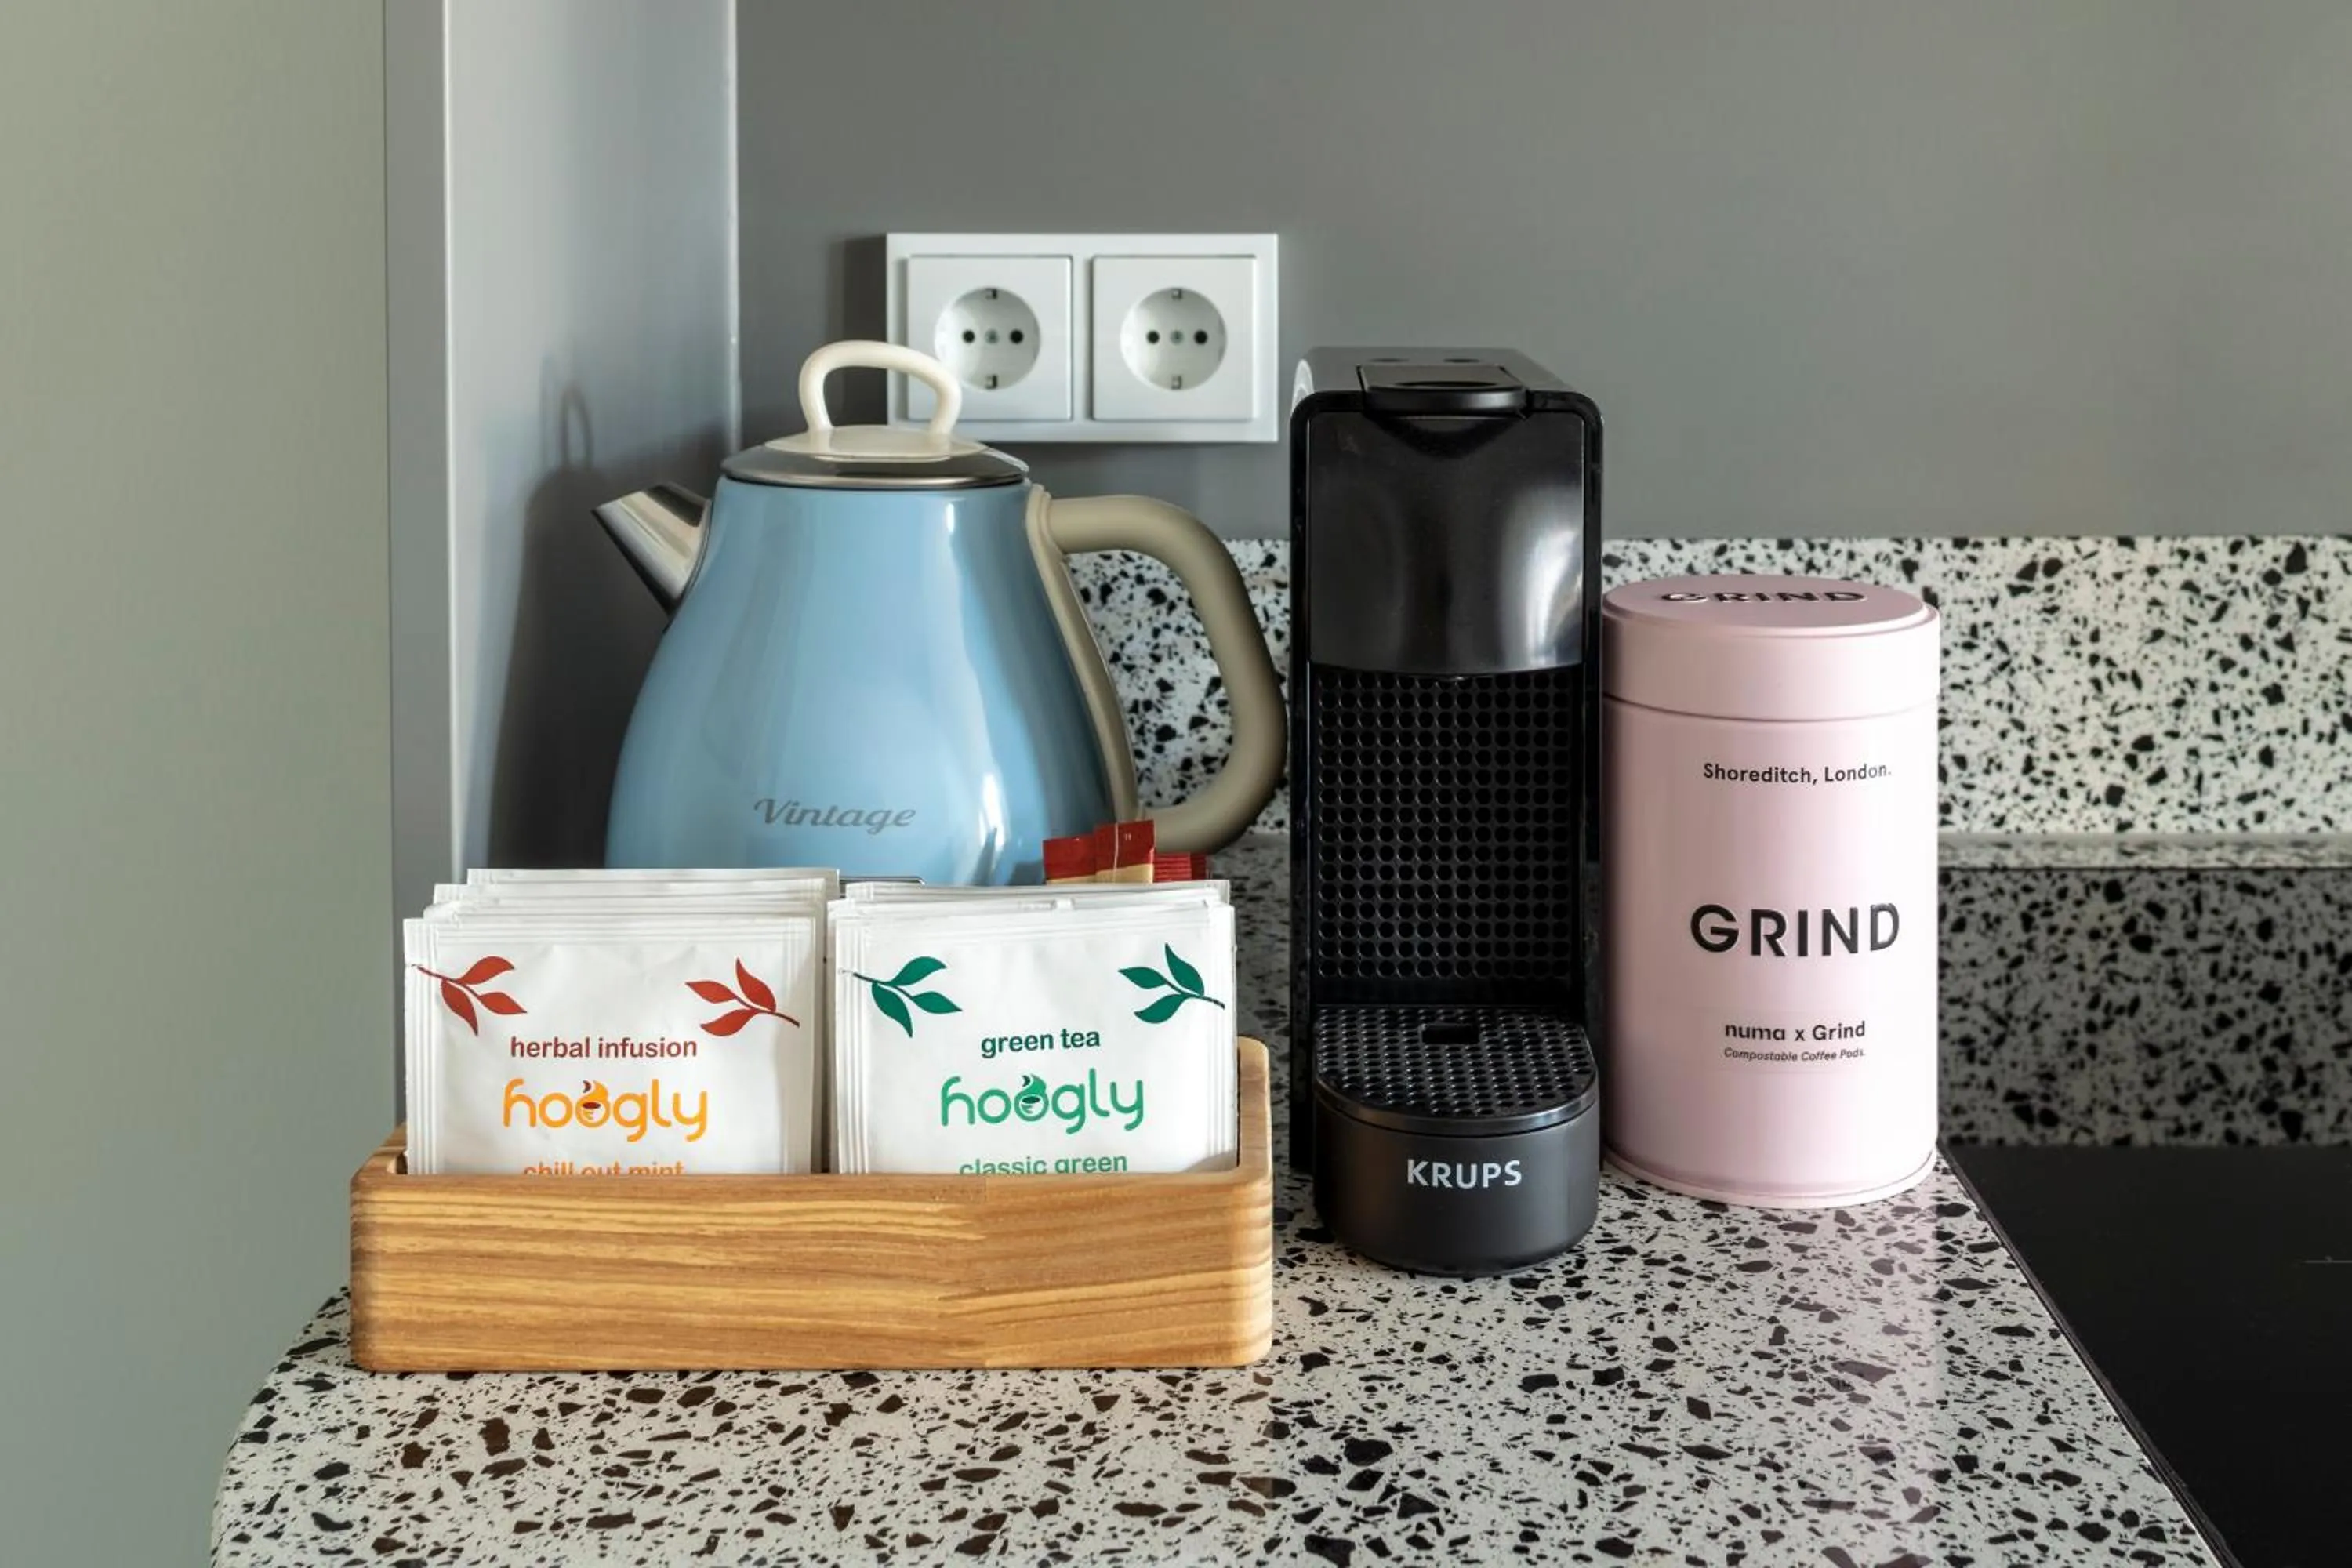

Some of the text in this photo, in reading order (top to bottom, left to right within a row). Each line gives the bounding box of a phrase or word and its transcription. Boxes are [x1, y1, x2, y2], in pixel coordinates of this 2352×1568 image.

[1661, 591, 1867, 603] GRIND
[1703, 762, 1892, 785] Shoreditch, London.
[753, 797, 916, 836] Vintage
[1690, 903, 1900, 957] GRIND
[981, 1028, 1101, 1059] green tea
[1725, 1020, 1866, 1041] numa x Grind
[510, 1036, 698, 1058] herbal infusion
[1724, 1047, 1798, 1062] Compostable
[1801, 1051, 1838, 1062] Coffee
[503, 1078, 708, 1142] hoogly
[940, 1067, 1145, 1134] hoogly
[959, 1156, 1047, 1175] classic
[1407, 1158, 1523, 1189] KRUPS
